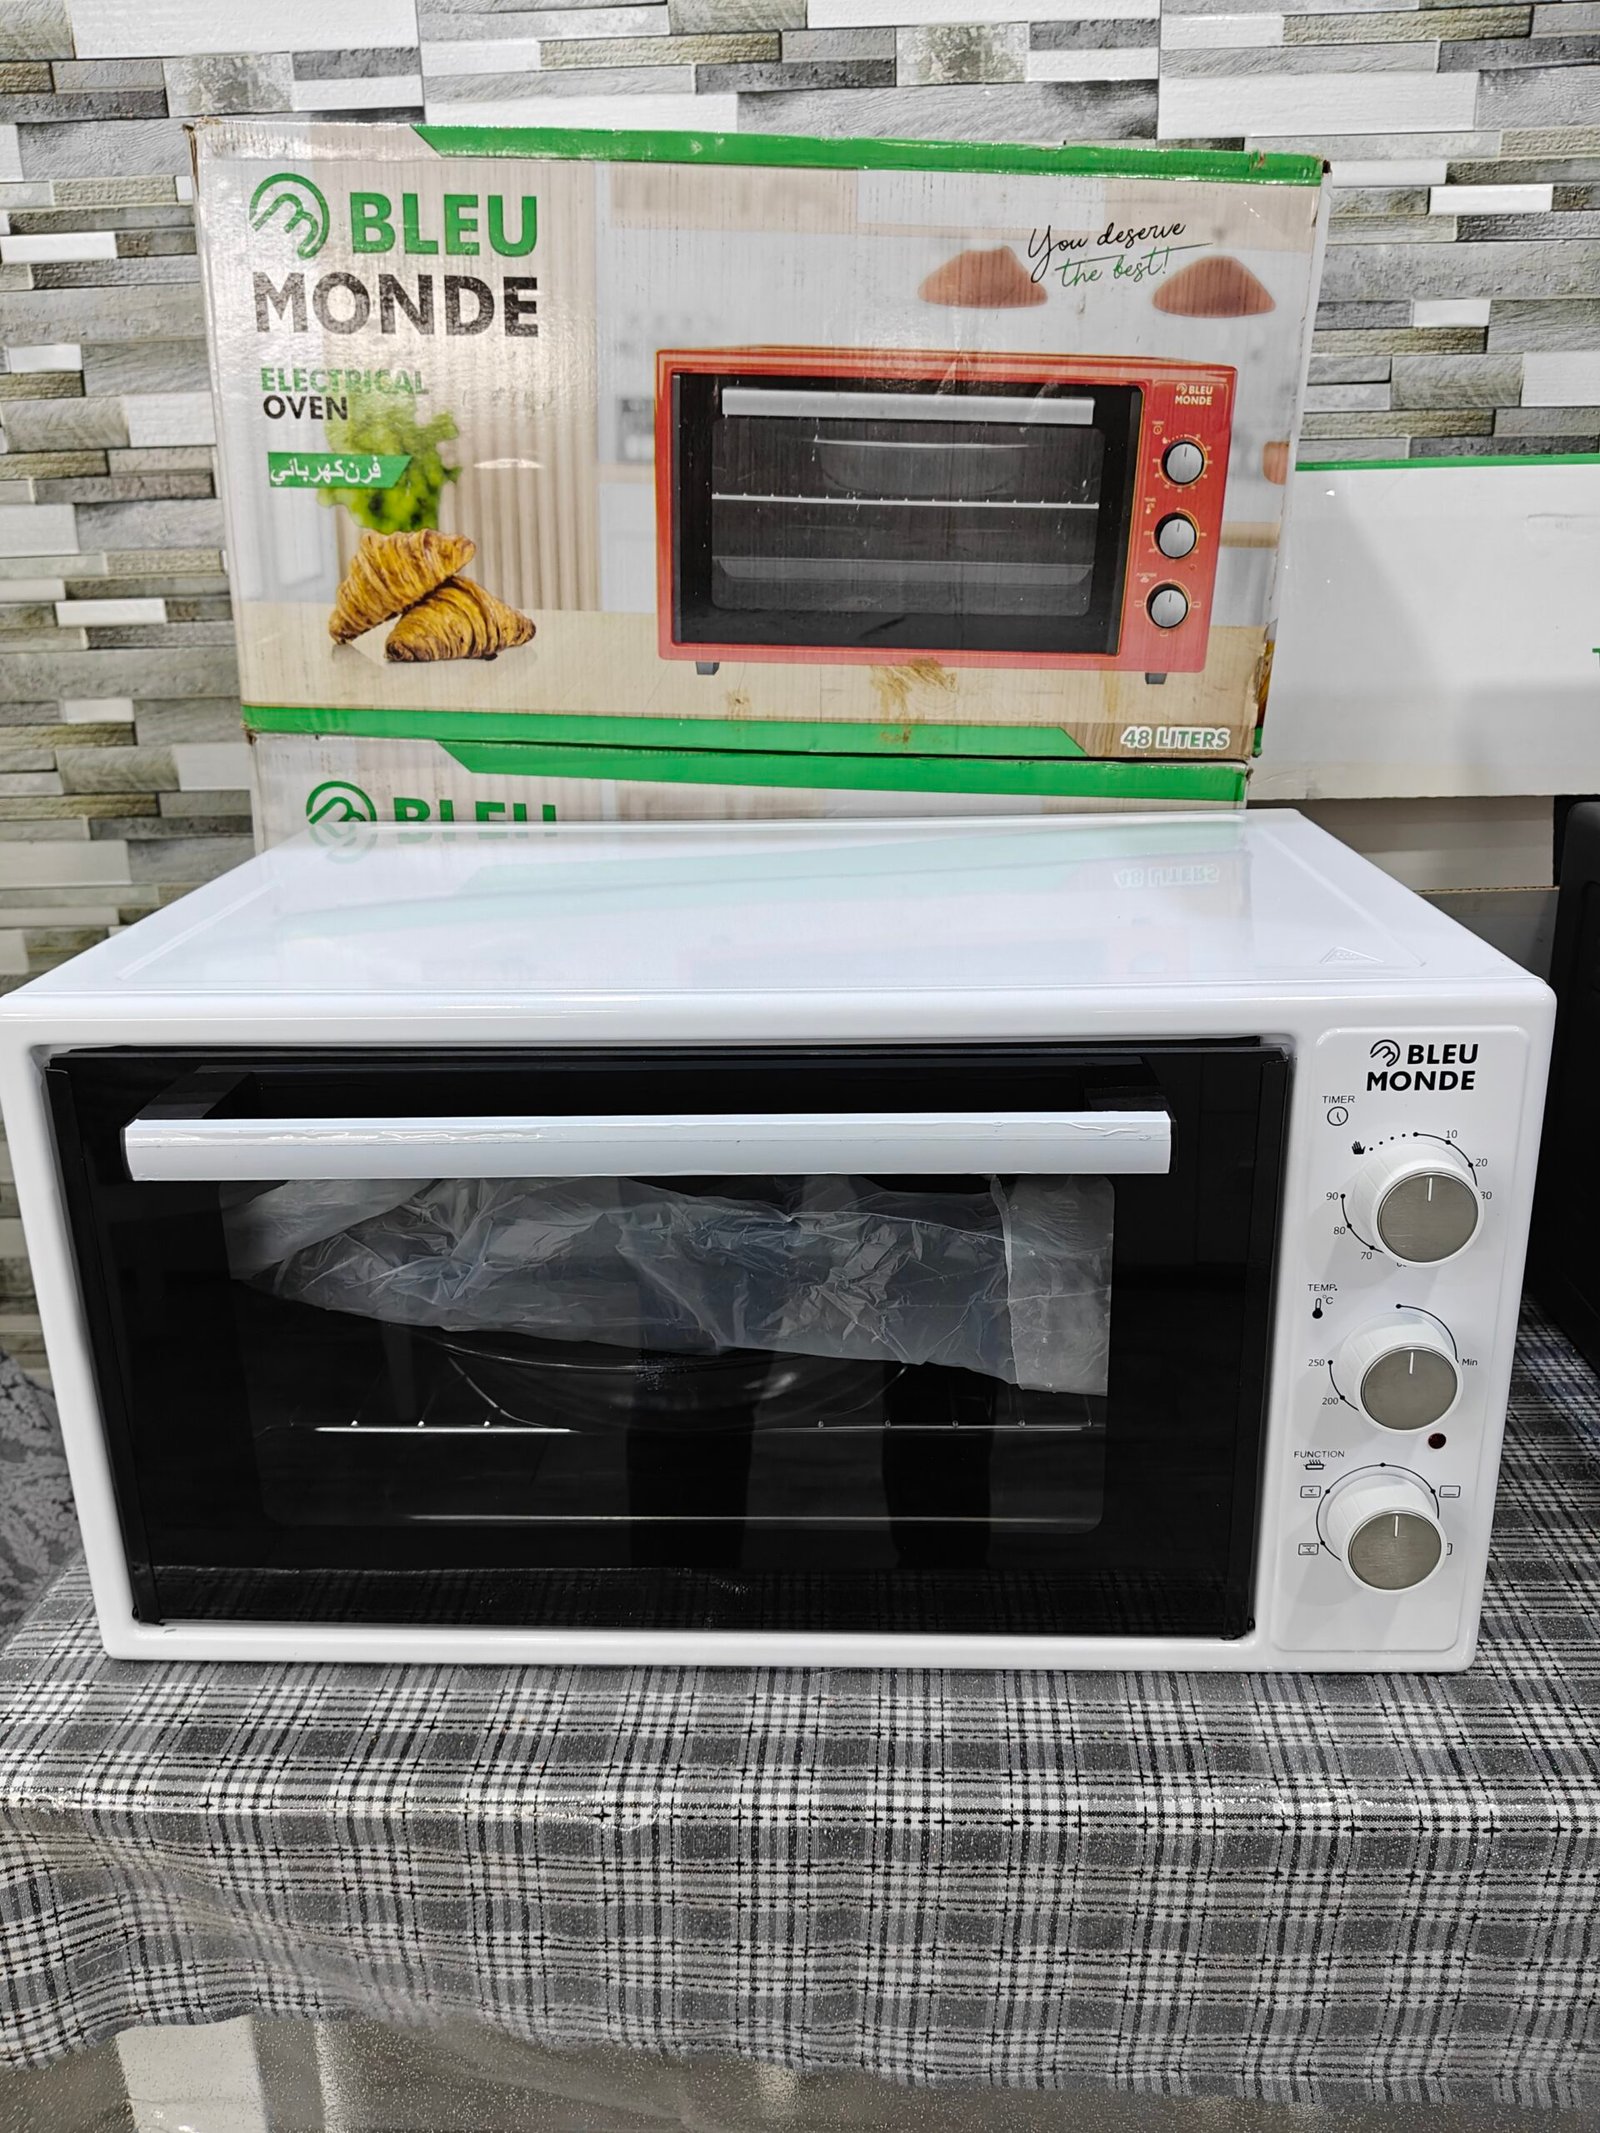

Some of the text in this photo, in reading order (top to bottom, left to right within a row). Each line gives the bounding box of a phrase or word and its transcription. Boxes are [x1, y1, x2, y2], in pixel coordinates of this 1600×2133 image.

[350, 191, 538, 258] BLEU
[1028, 221, 1187, 284] You deserve
[1055, 246, 1172, 288] the best!
[252, 271, 539, 338] MONDE
[260, 366, 430, 396] ELECTRICAL
[1188, 384, 1215, 396] BLEU
[1174, 395, 1214, 406] MONDE
[262, 395, 349, 421] OVEN
[270, 455, 382, 486] فرن كهربائي
[1121, 728, 1231, 750] 48 LITERS
[1406, 1043, 1479, 1066] BLEU
[1366, 1070, 1477, 1092] MONDE
[1322, 1095, 1356, 1104] TIMER
[1446, 1129, 1458, 1139] 10
[1475, 1158, 1488, 1168] 20
[1326, 1191, 1339, 1201] 90
[1480, 1191, 1493, 1200] 30
[1333, 1226, 1346, 1235] 80
[1360, 1251, 1373, 1260] 70
[1307, 1283, 1338, 1292] TEMP.
[1308, 1358, 1325, 1367] 250
[1462, 1358, 1478, 1367] Min
[1322, 1397, 1339, 1406] 200
[1294, 1451, 1345, 1459] FUNCTION
